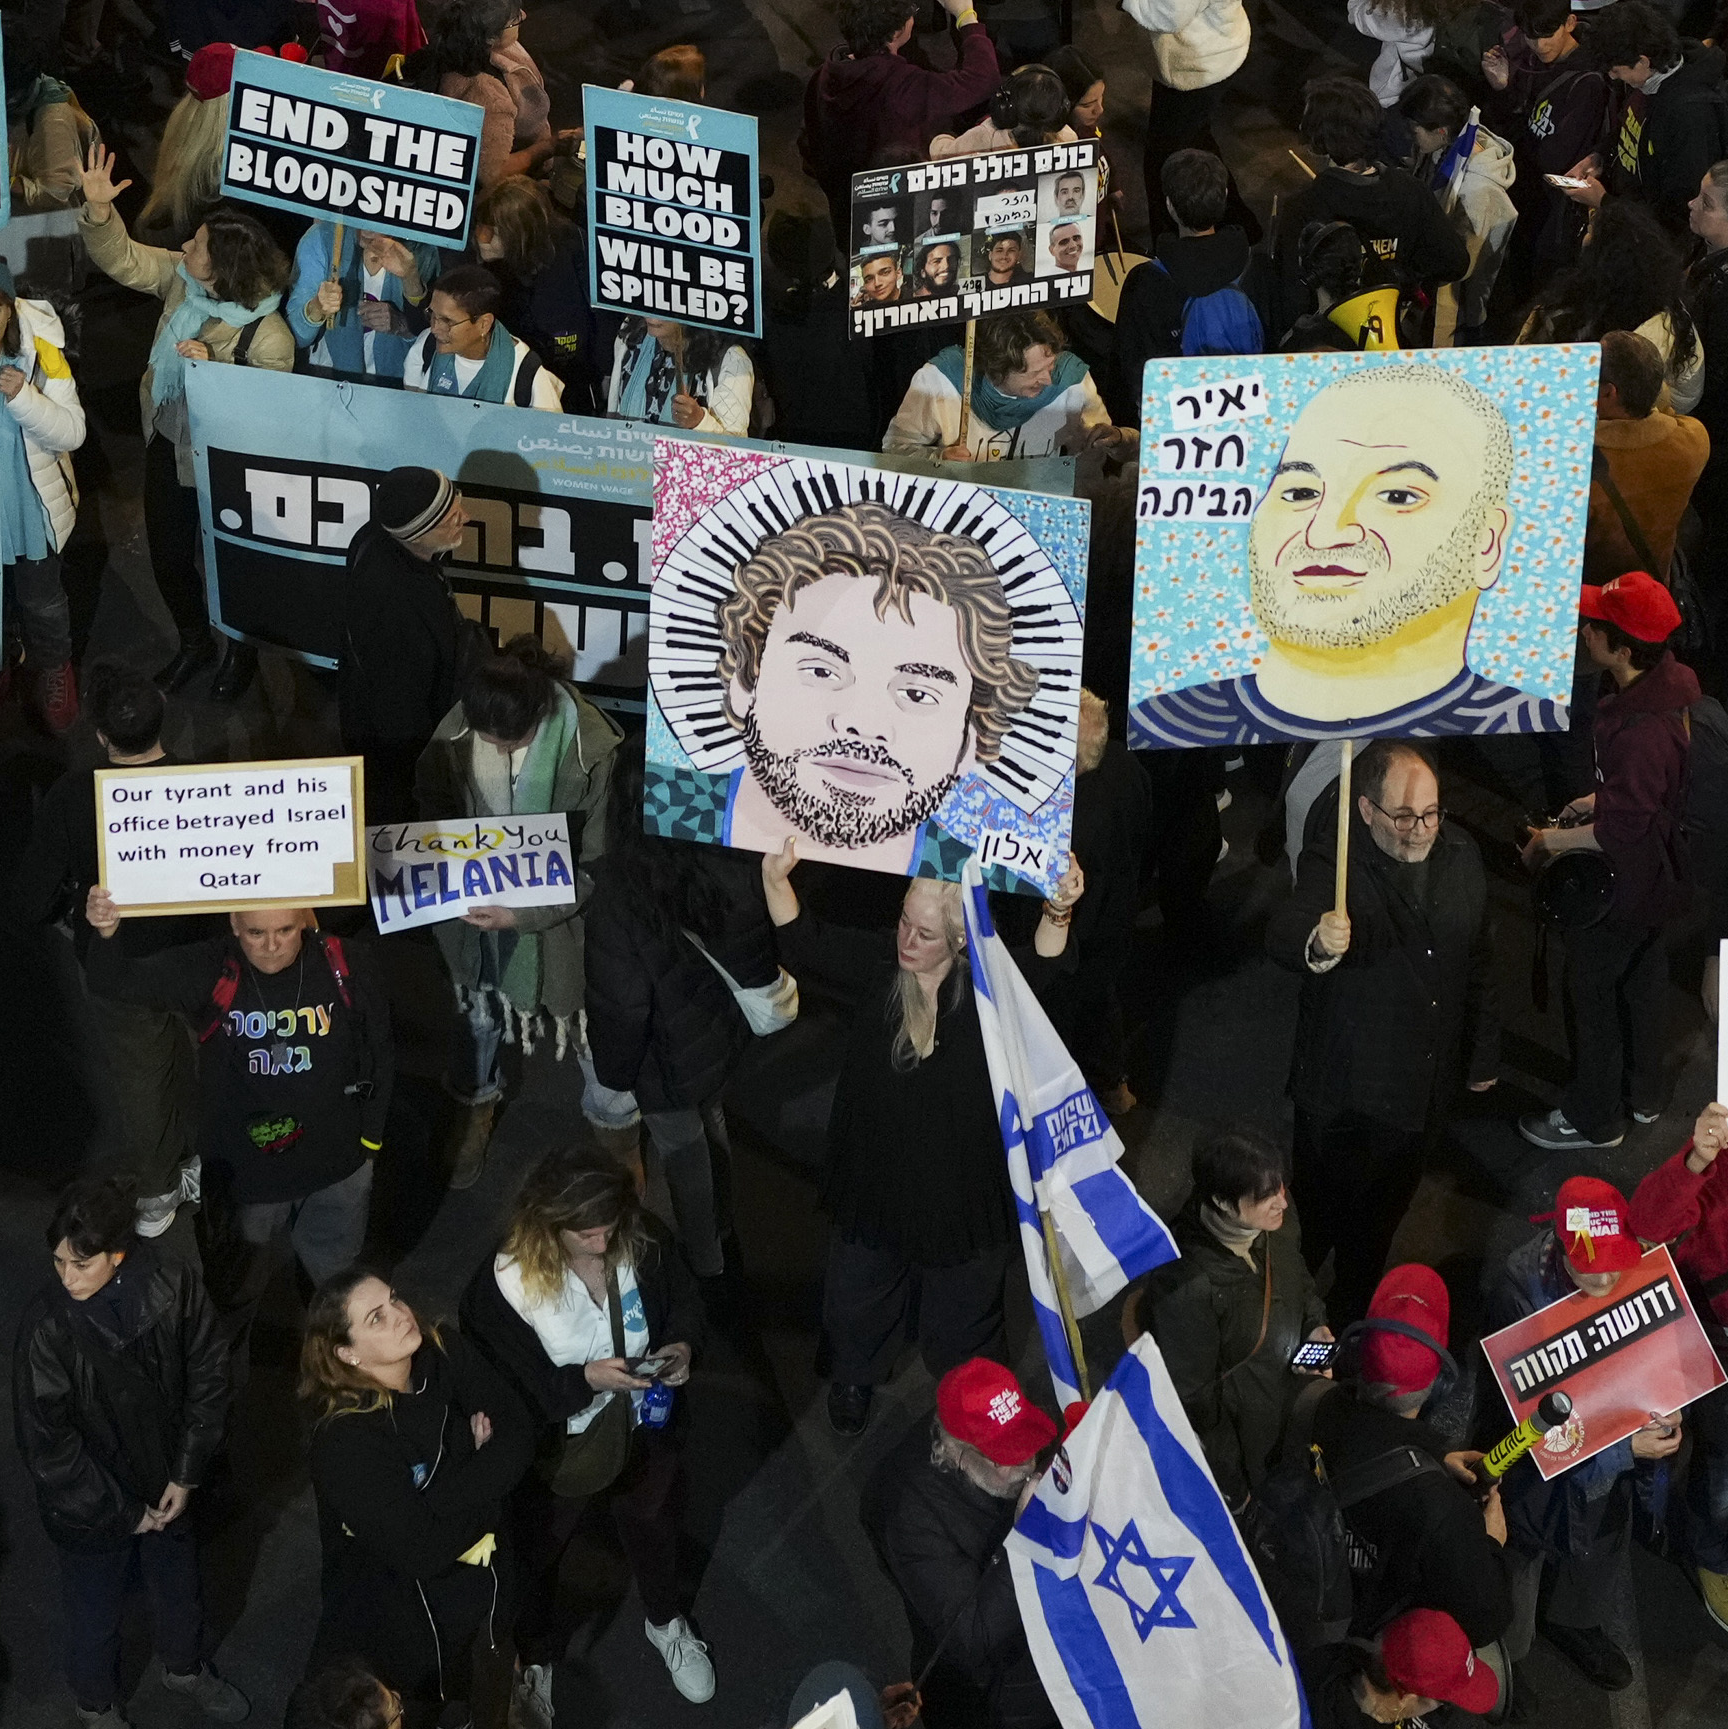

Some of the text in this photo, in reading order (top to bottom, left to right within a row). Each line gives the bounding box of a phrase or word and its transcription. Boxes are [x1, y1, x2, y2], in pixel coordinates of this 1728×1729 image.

[237, 86, 469, 181] END THE
[616, 129, 723, 172] HOW
[226, 143, 466, 232] BLOODSHED
[606, 169, 734, 214] MUCH
[603, 195, 743, 249] BLOOD
[597, 233, 748, 293] WILL BE
[599, 271, 750, 326] SPILLED?
[1176, 383, 1260, 420] יאיר
[1163, 433, 1245, 470] חזר
[1139, 483, 1253, 518] הביתה
[111, 774, 328, 807] Our tyrant and his
[107, 801, 347, 836] office betrayed Israel
[117, 834, 321, 864] with money from
[503, 825, 569, 855] You
[981, 832, 1043, 869] אלון
[198, 868, 263, 892] Qatar
[374, 848, 572, 925] MELANIA
[1510, 1280, 1675, 1393] דרושה: תקווה
